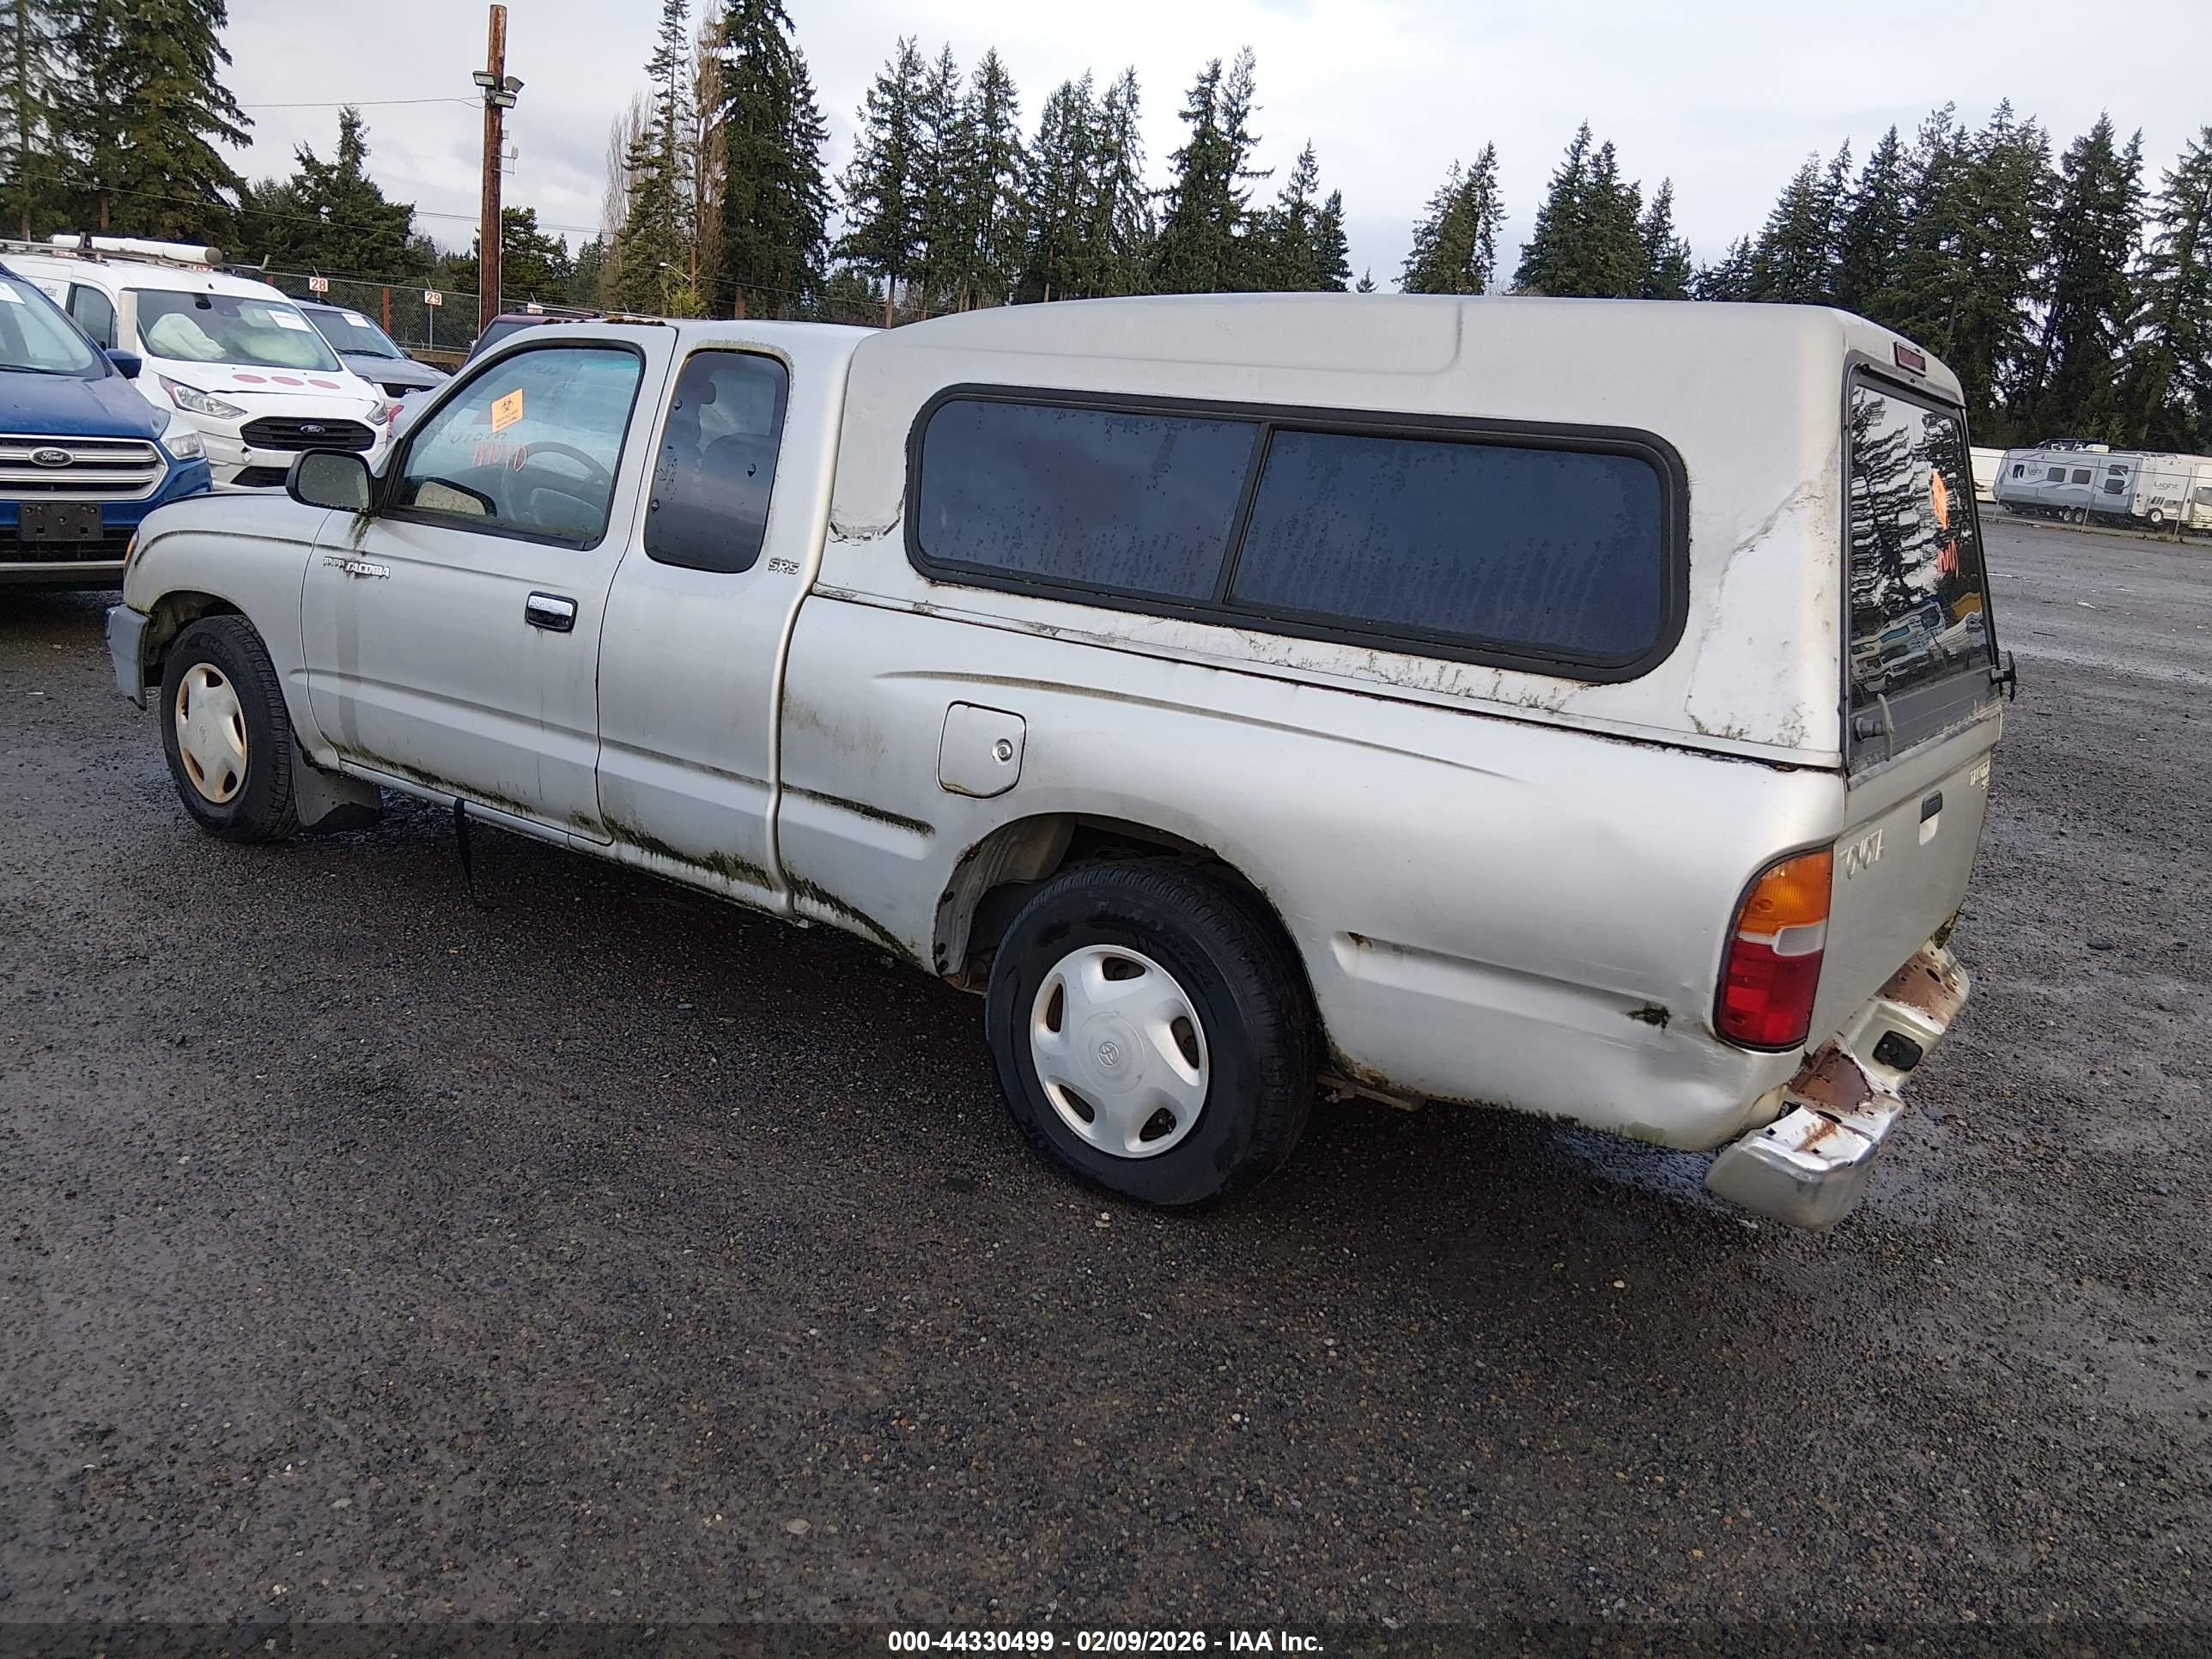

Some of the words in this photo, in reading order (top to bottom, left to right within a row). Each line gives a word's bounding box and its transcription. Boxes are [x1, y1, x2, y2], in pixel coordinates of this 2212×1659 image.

[311, 278, 326, 291] 28
[426, 292, 441, 304] 29
[41, 451, 64, 461] Ford
[345, 562, 390, 578] TACOMA
